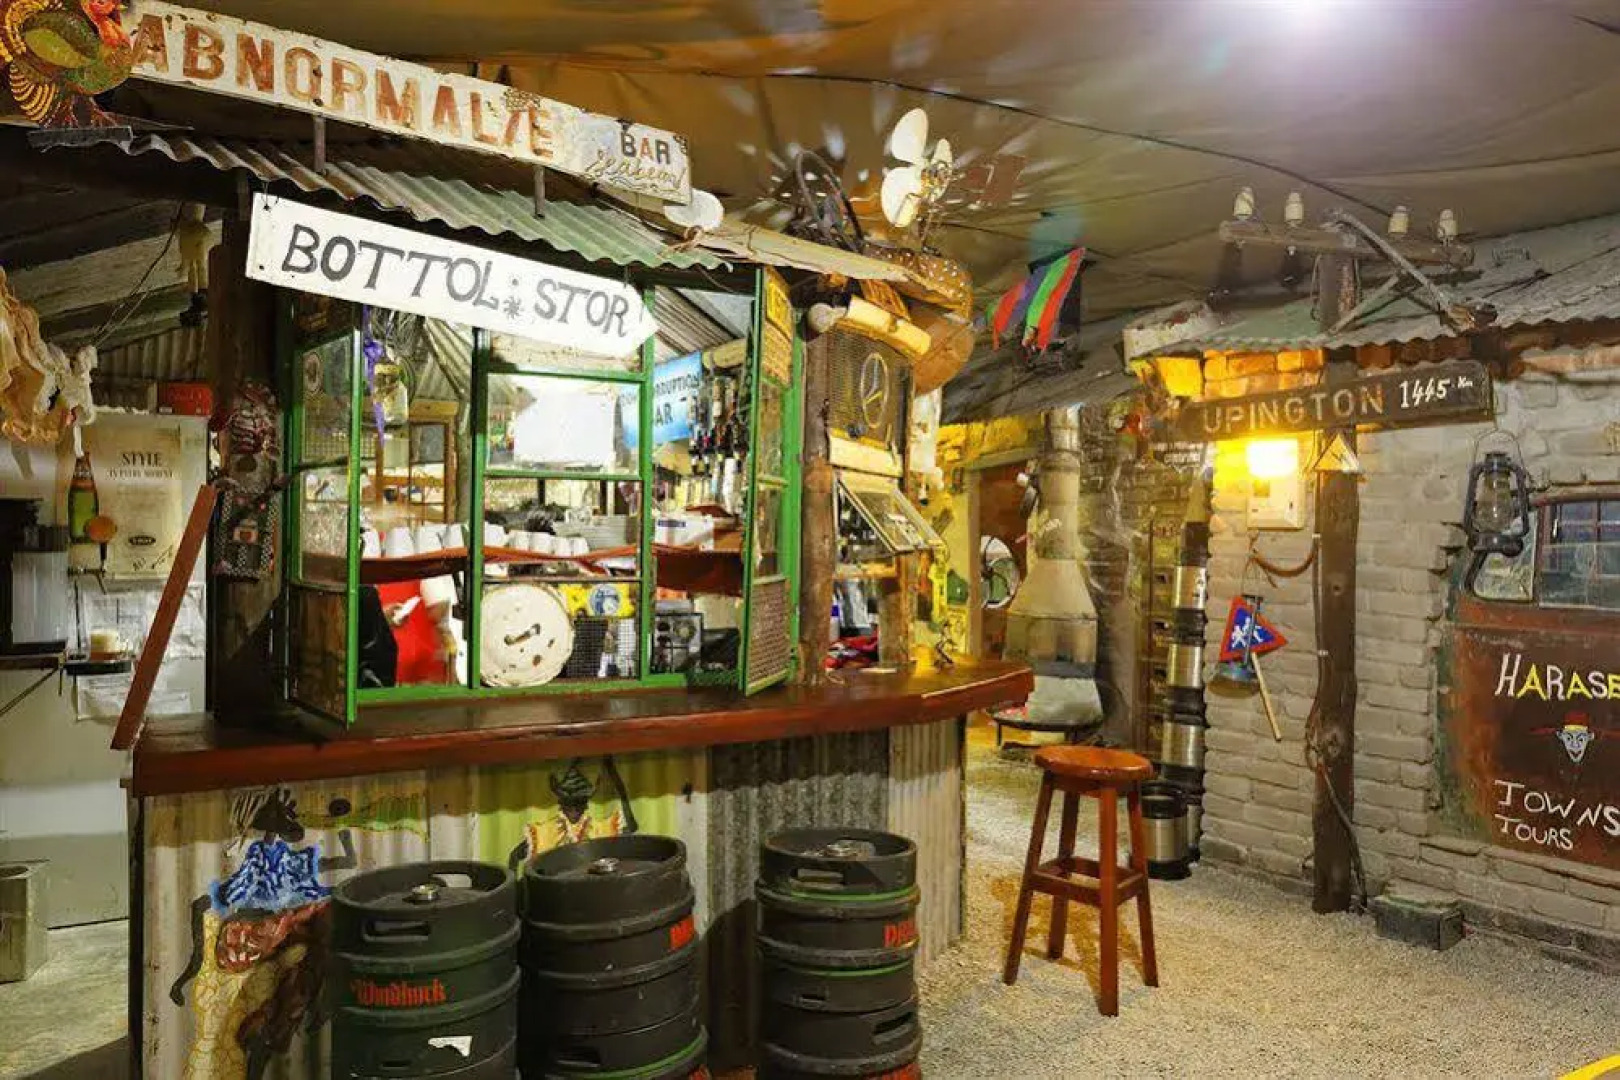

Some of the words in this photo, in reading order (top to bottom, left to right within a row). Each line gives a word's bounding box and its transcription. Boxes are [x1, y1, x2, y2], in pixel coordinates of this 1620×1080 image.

[620, 131, 671, 165] BAR
[281, 224, 499, 307] BOTTOL
[534, 278, 629, 338] STOR
[1202, 383, 1384, 434] UPINGTON
[1399, 378, 1451, 409] 1445
[120, 451, 162, 467] STYLE
[1494, 812, 1574, 850] TOURS
